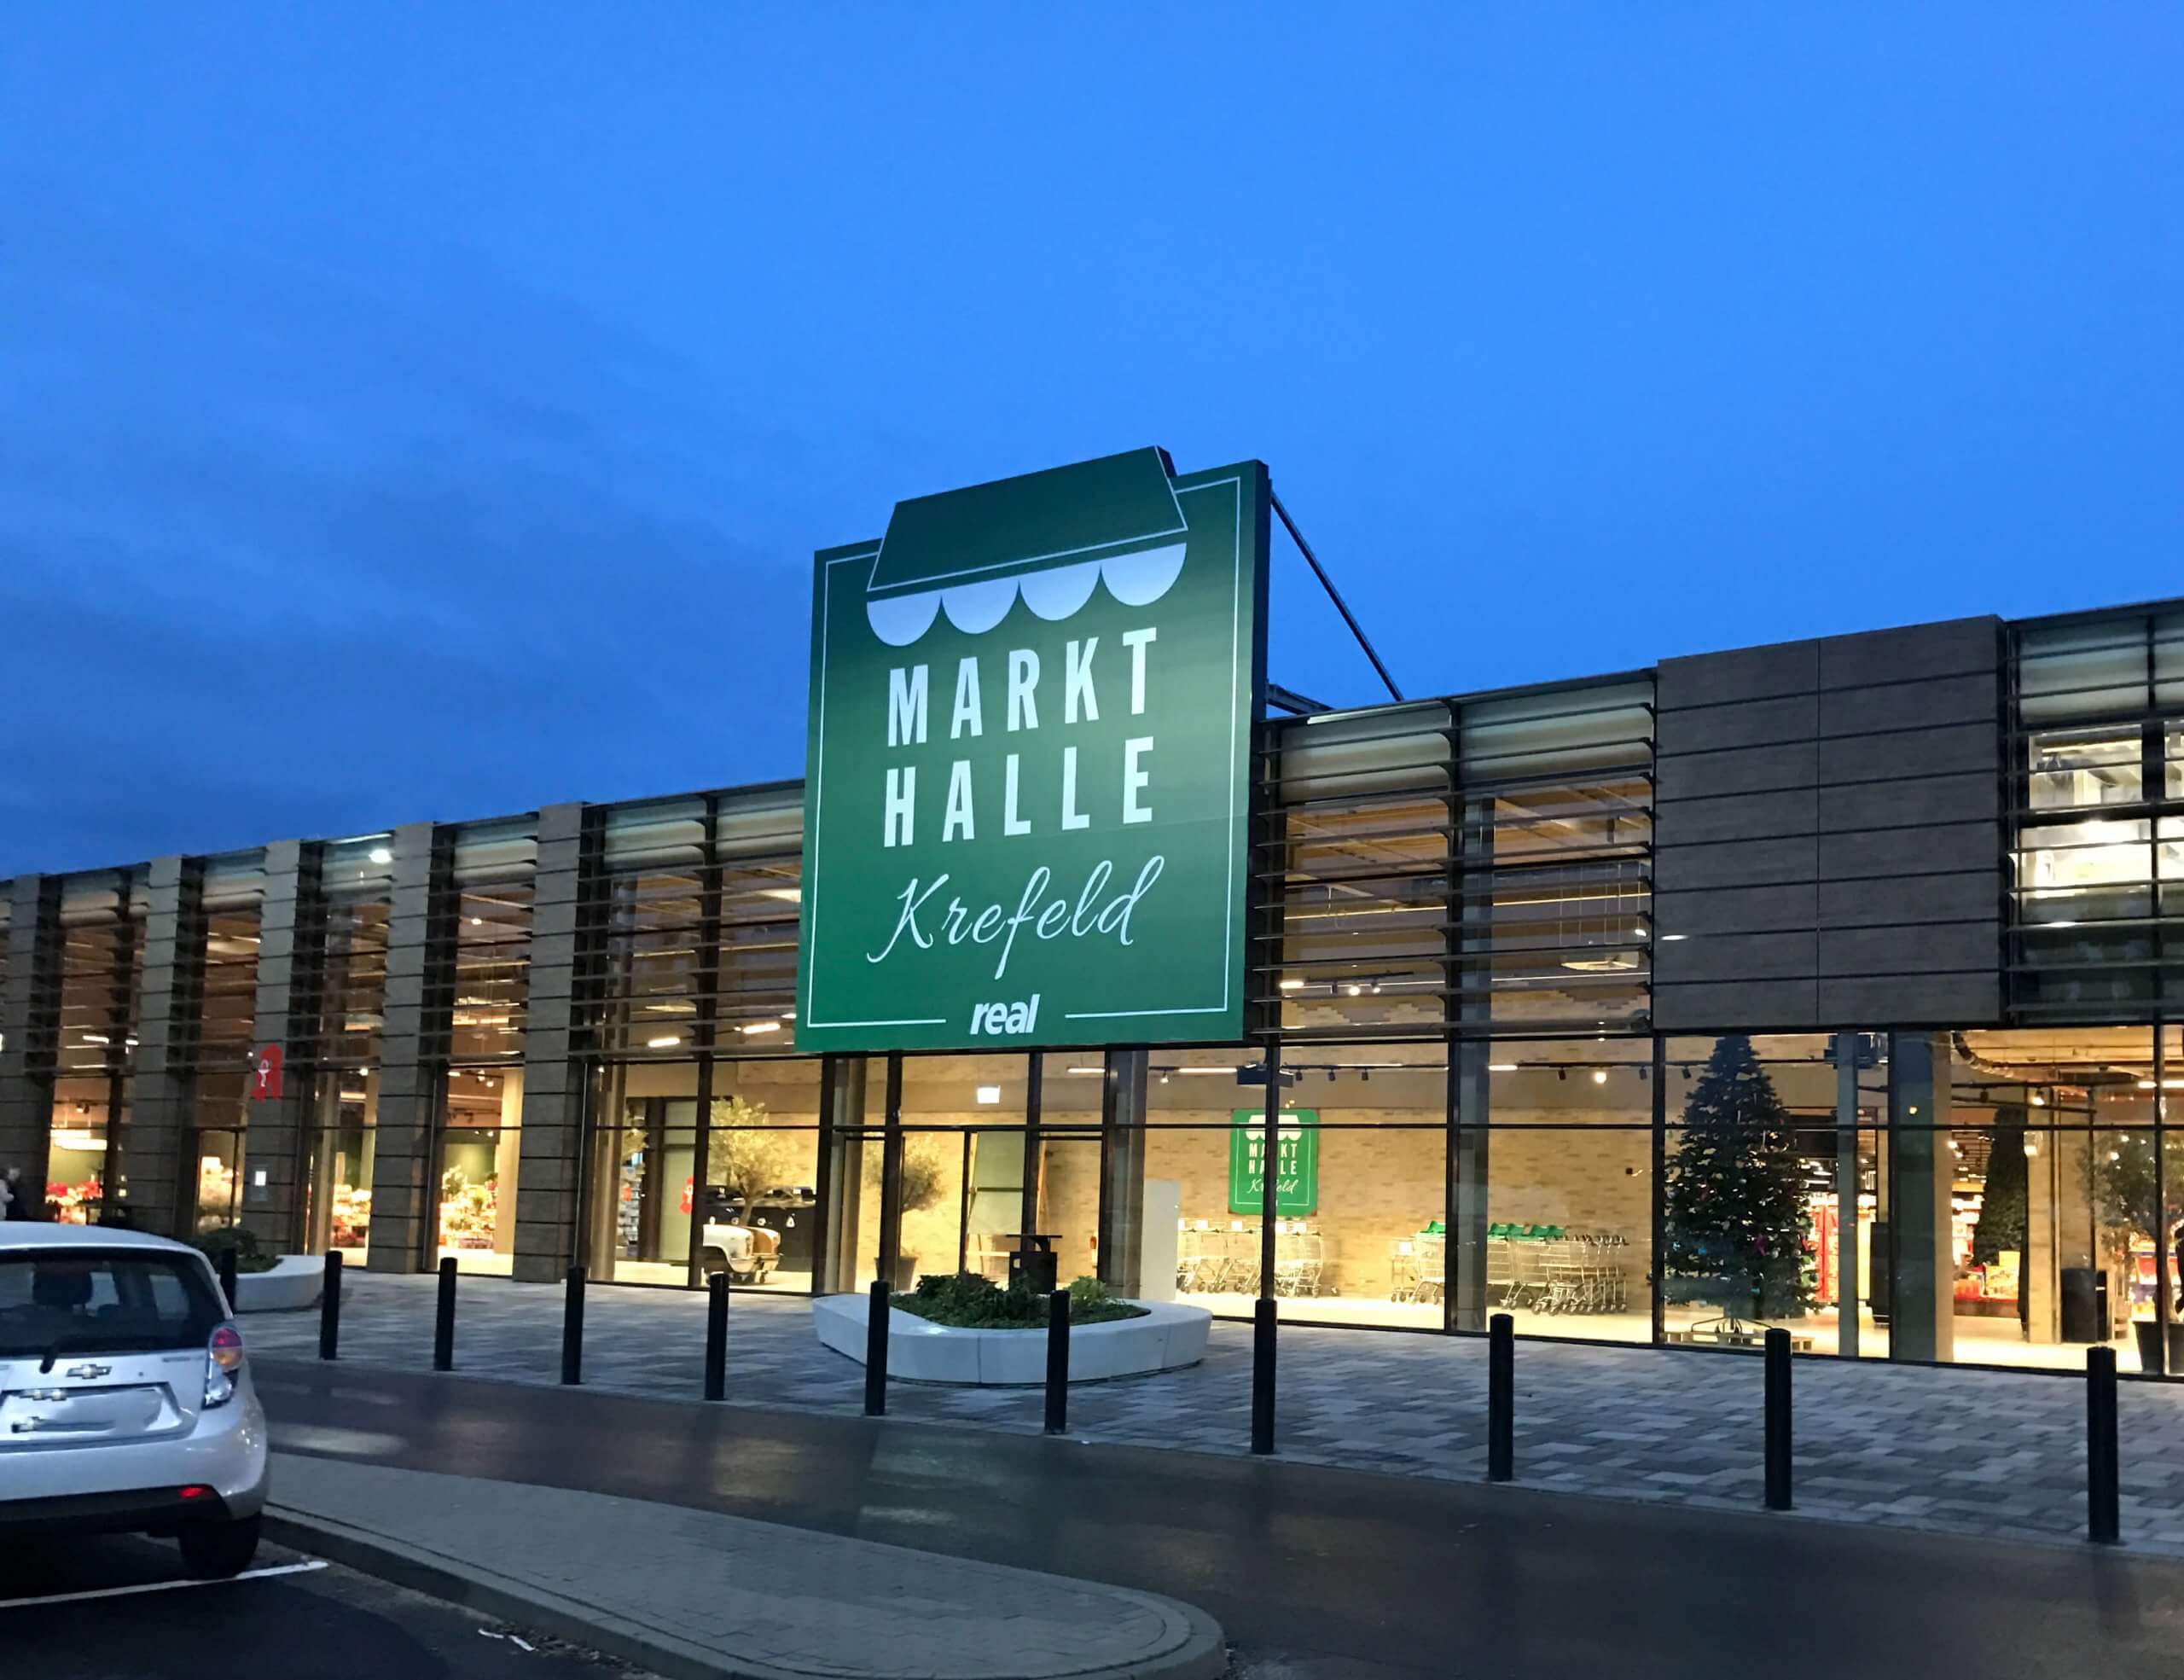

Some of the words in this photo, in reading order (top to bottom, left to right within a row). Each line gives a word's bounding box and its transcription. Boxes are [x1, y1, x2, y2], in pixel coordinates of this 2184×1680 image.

[887, 627, 1157, 747] MARKT
[883, 736, 1154, 848] HALLE
[867, 855, 1165, 980] Krefeld
[969, 993, 1041, 1035] real
